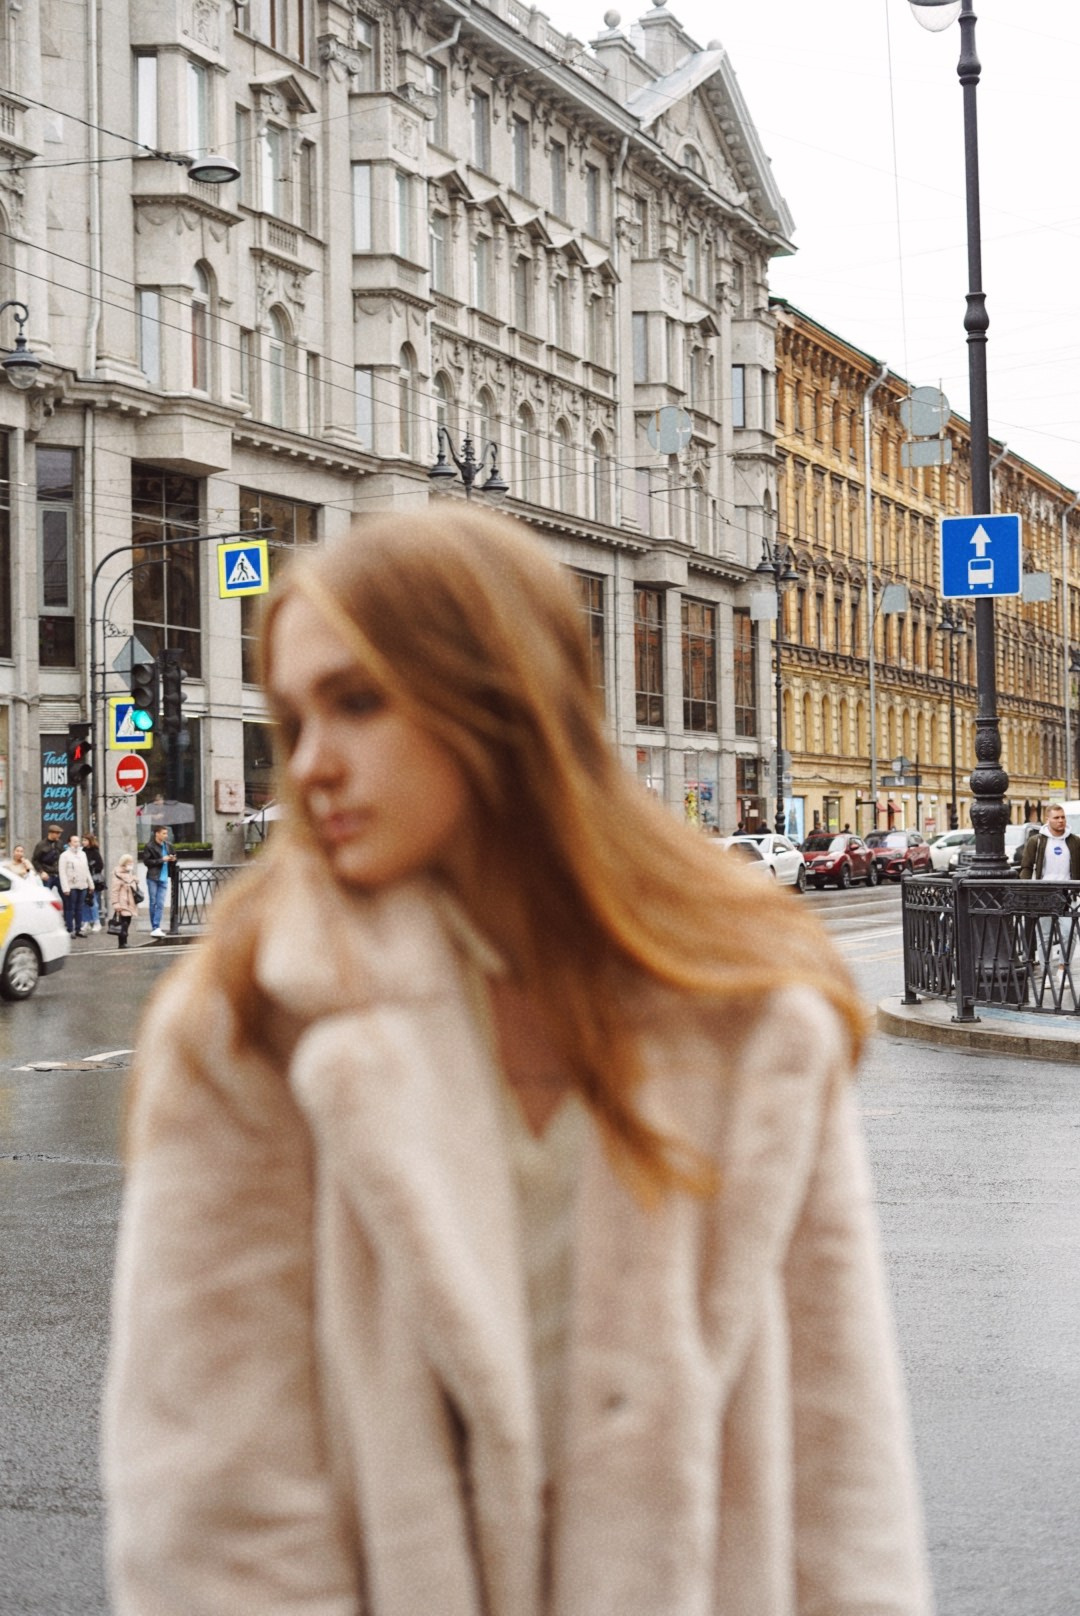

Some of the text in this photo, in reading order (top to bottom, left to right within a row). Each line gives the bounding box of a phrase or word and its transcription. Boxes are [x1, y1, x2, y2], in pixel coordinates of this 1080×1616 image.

[43, 751, 68, 766] Tast
[43, 767, 68, 785] MUSI
[44, 787, 75, 798] EVERY
[45, 797, 73, 810] week
[43, 807, 75, 821] ends
